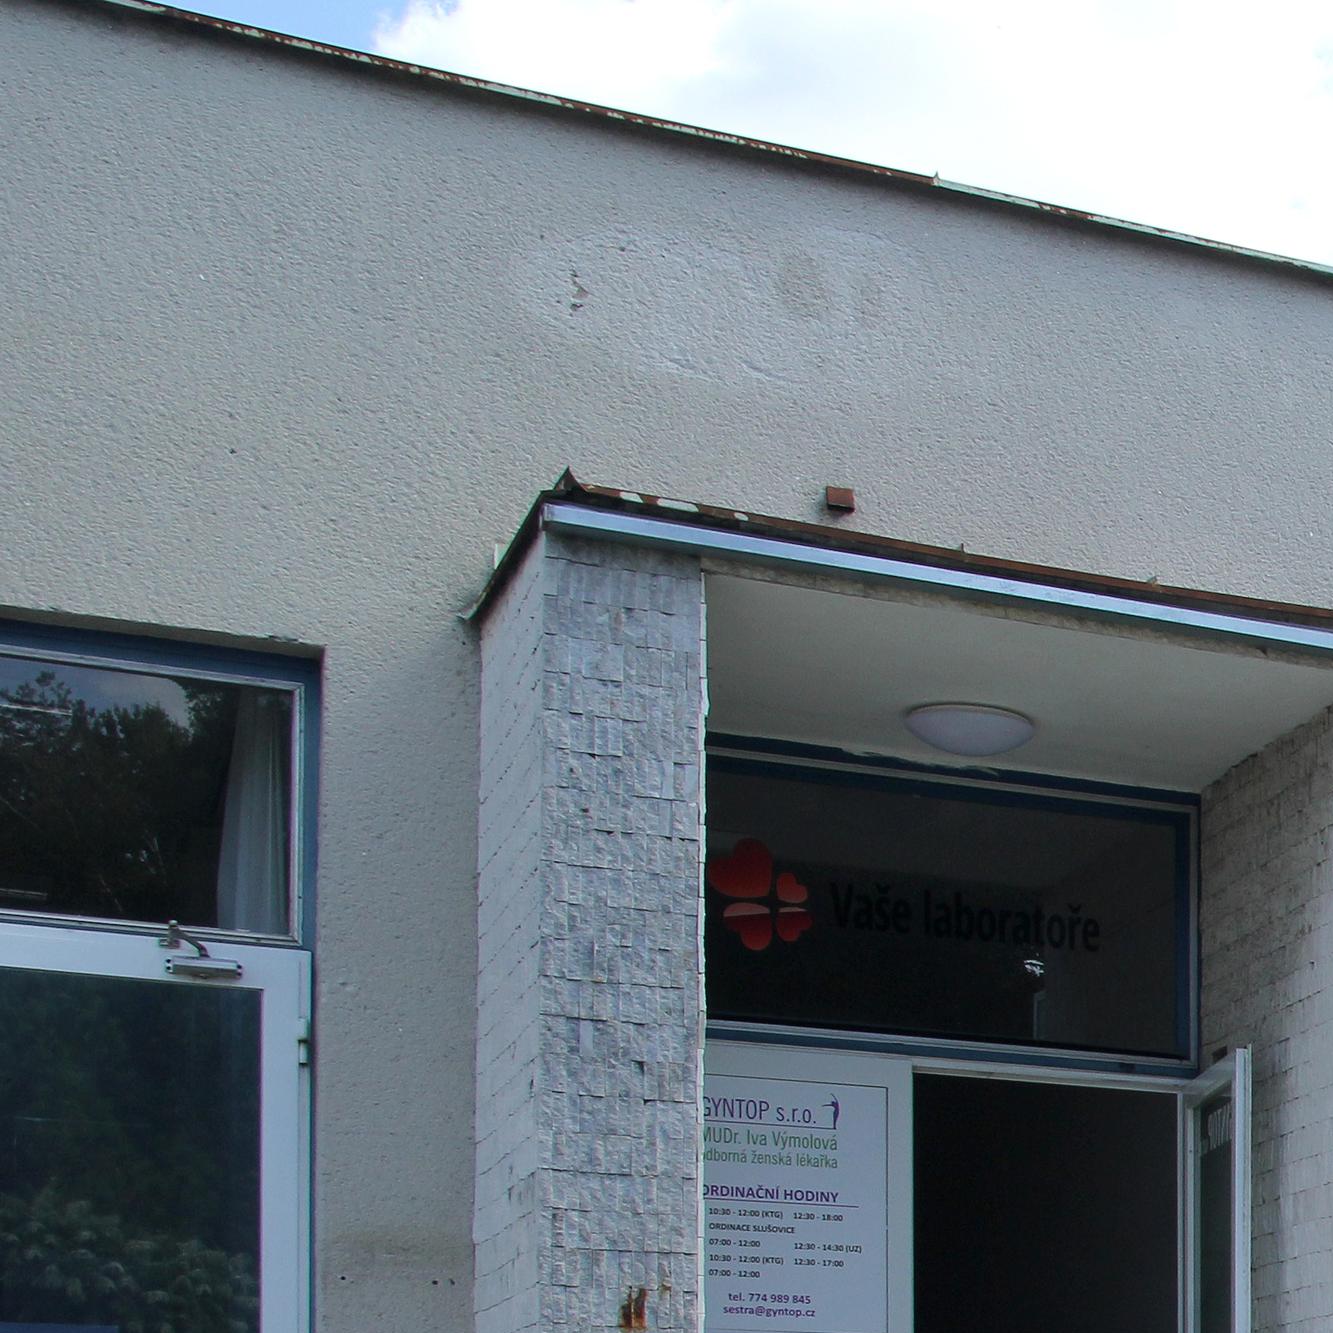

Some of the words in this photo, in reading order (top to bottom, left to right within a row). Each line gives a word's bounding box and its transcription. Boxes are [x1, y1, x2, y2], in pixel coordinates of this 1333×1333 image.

[830, 882, 912, 934] Vaše
[923, 889, 1101, 952] laboratoře
[703, 1096, 770, 1120] GYNTOP
[776, 1106, 817, 1124] s.r.o.
[747, 1129, 767, 1145] Iva
[772, 1131, 838, 1150] Výmolová
[751, 1150, 792, 1166] ženská
[796, 1152, 838, 1169] lékařka
[703, 1184, 779, 1199] ORDINAČNÍ
[784, 1189, 839, 1203] HODINY
[709, 1208, 731, 1216] 10:30
[738, 1209, 760, 1217] 12:00
[709, 1223, 751, 1231] ORDINACE
[753, 1225, 795, 1234] SLUŠOVICE
[728, 1293, 745, 1302] tel.
[748, 1293, 767, 1302] 774
[770, 1294, 790, 1303] 989
[792, 1294, 811, 1304] 845
[723, 1304, 815, 1318] sestra@gyntop.cz
